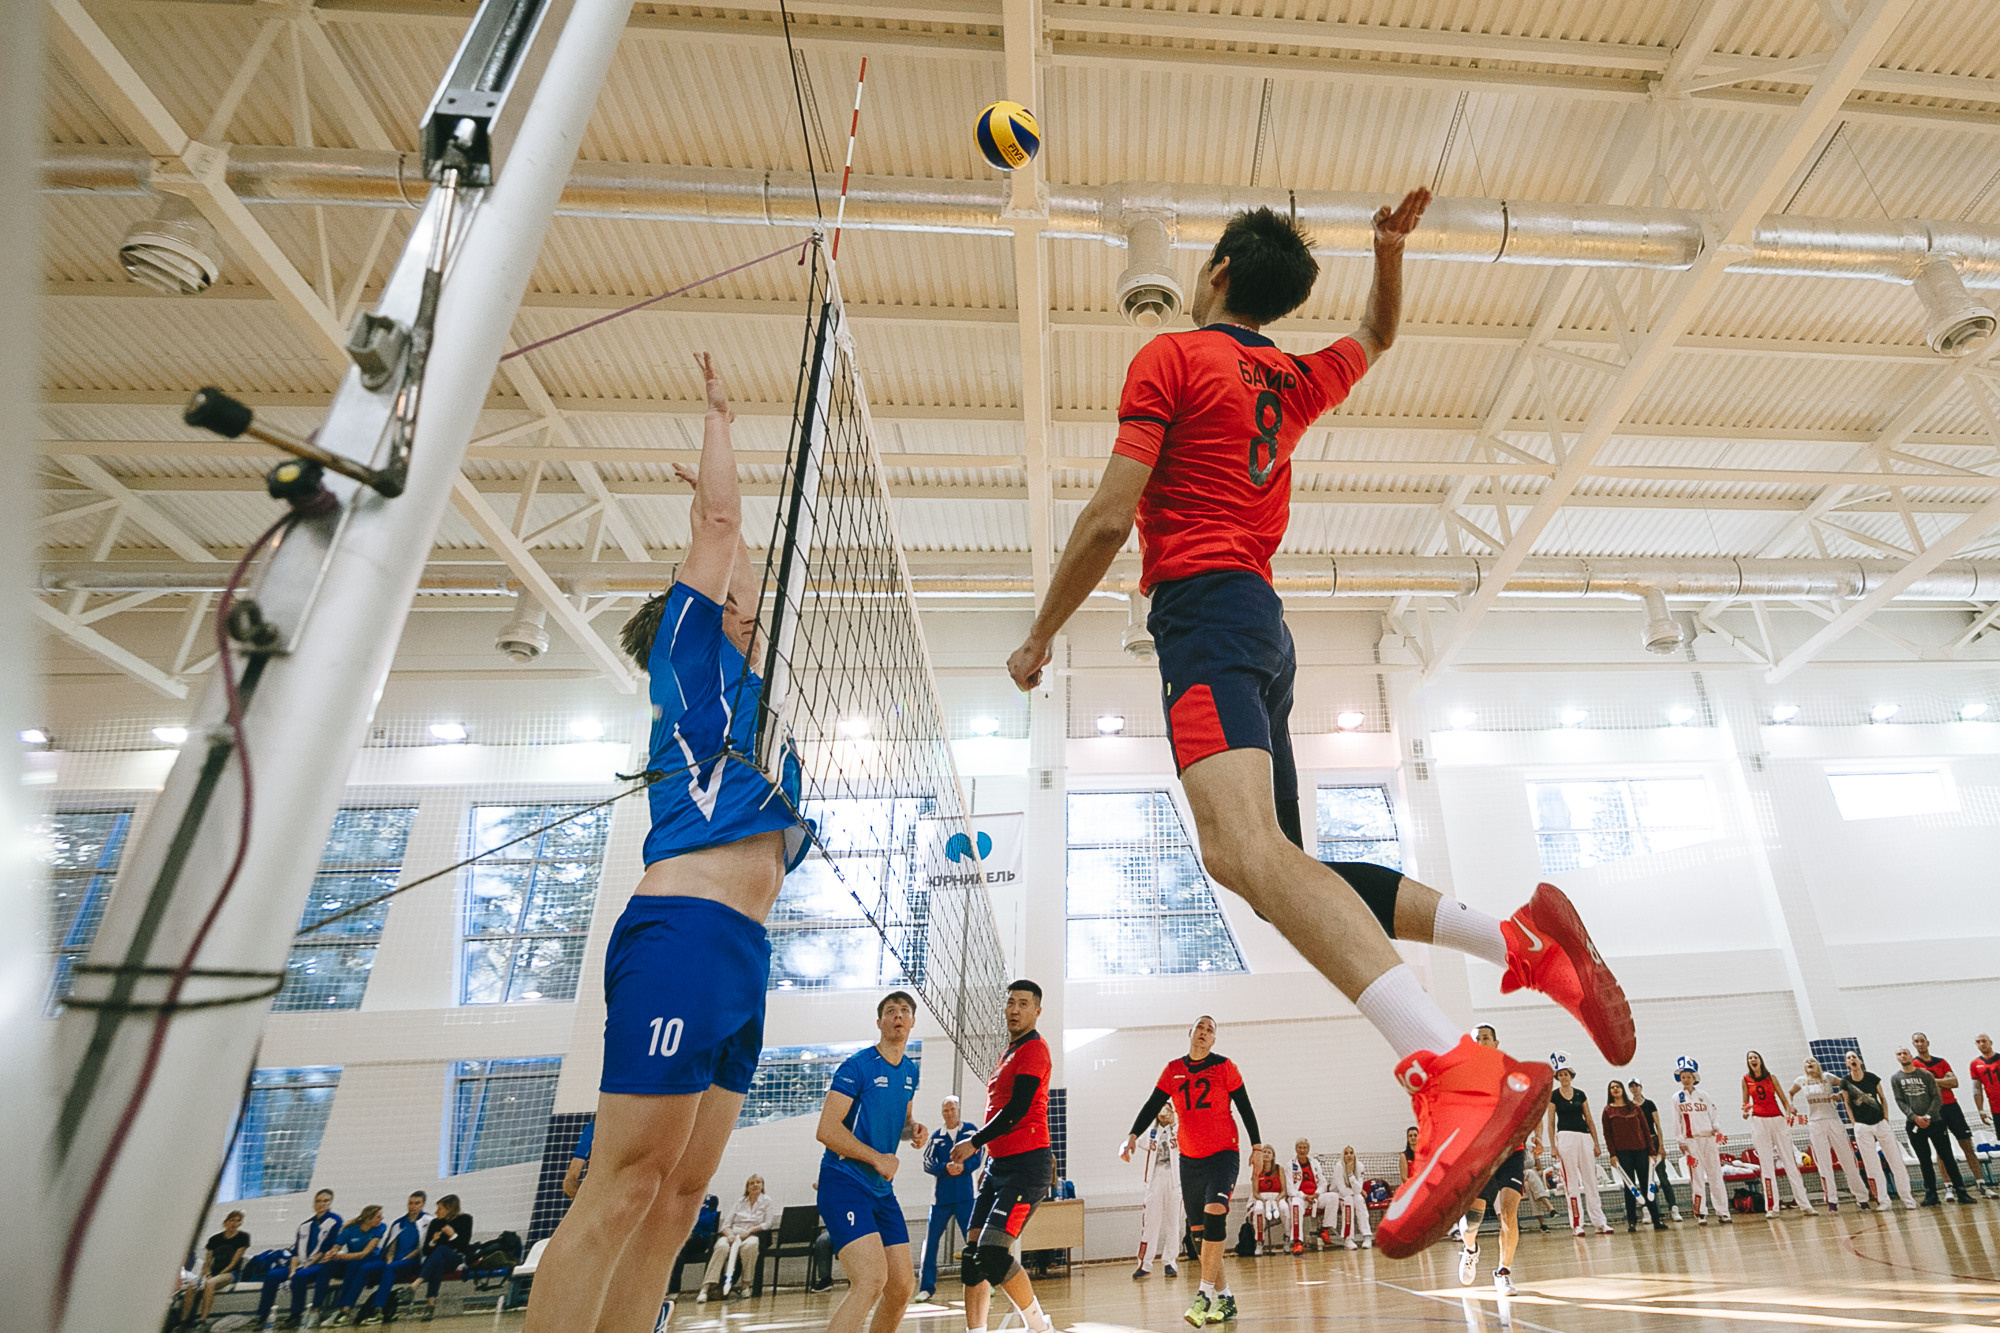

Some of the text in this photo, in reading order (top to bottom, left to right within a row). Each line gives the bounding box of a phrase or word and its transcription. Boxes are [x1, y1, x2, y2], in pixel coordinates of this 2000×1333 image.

[1248, 389, 1283, 487] 8
[648, 1016, 684, 1057] 10
[1983, 1066, 2000, 1087] 11
[1178, 1077, 1212, 1111] 12
[1755, 1085, 1767, 1101] 9
[846, 1210, 855, 1227] 9
